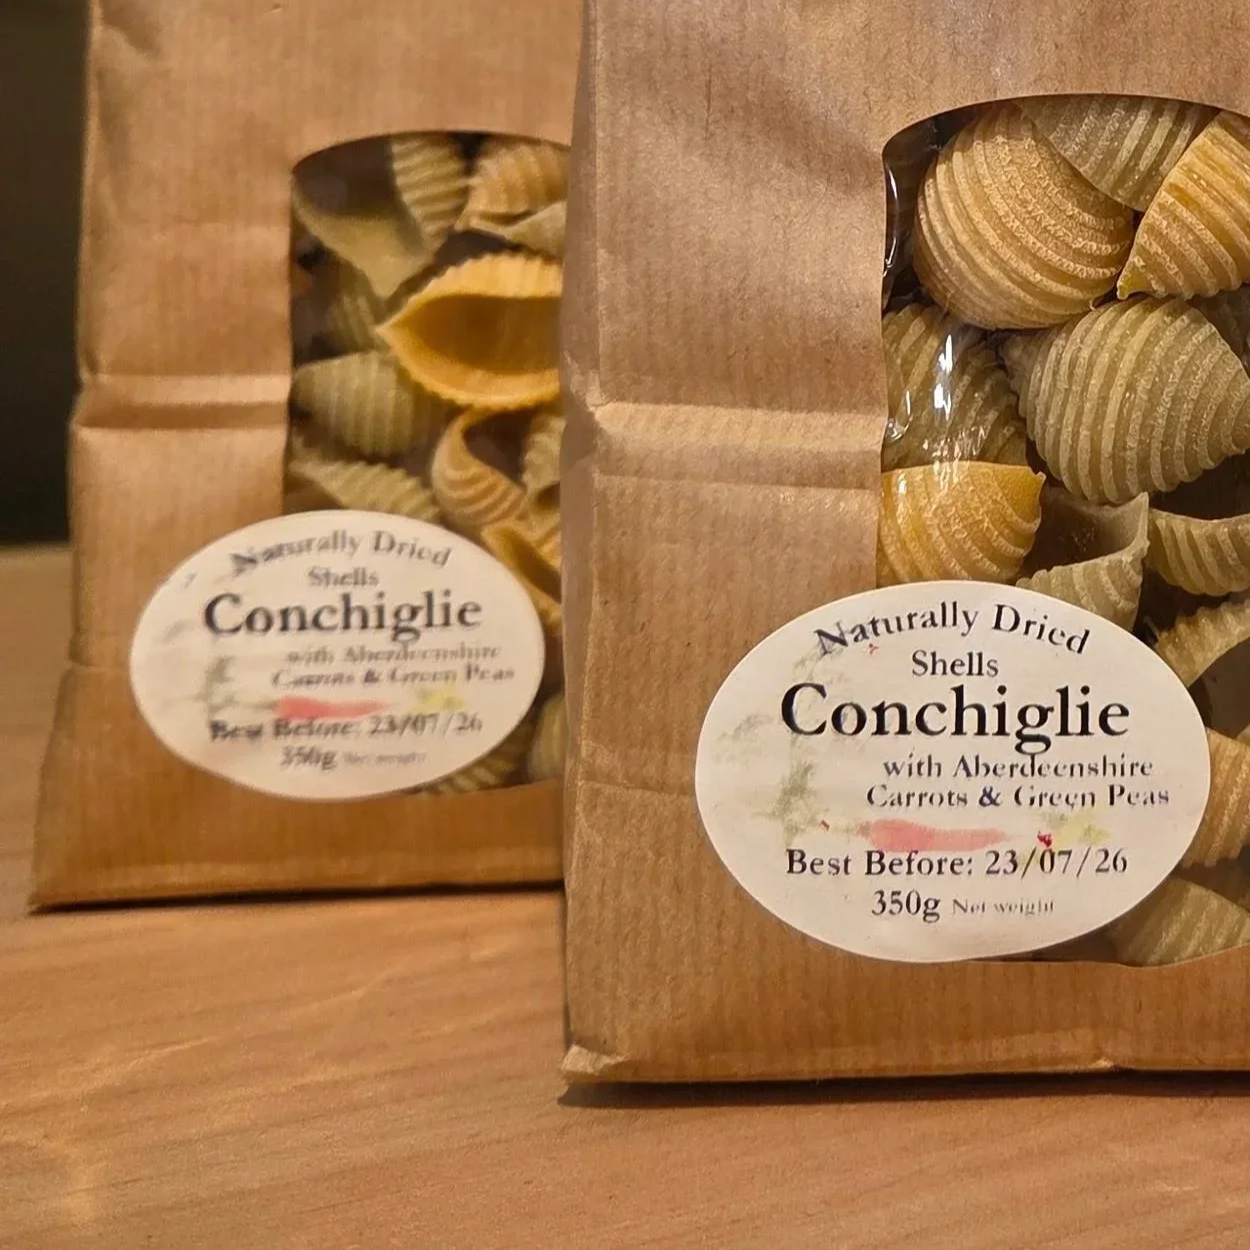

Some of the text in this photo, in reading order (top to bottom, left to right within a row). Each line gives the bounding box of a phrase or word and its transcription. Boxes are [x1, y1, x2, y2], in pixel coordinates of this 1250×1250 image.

[230, 529, 452, 576] Naturally Dried
[307, 566, 379, 587] Shells
[204, 589, 482, 643] Conchiglie
[814, 601, 1090, 655] Naturally Dried
[911, 649, 999, 678] Shells
[780, 682, 1130, 756] Conchiglie
[883, 753, 1154, 778] with Aberdeenshire
[867, 784, 1169, 810] Carrots & Green Peas
[786, 846, 1128, 879] Best Before: 23/07/26
[871, 889, 941, 923] 350g
